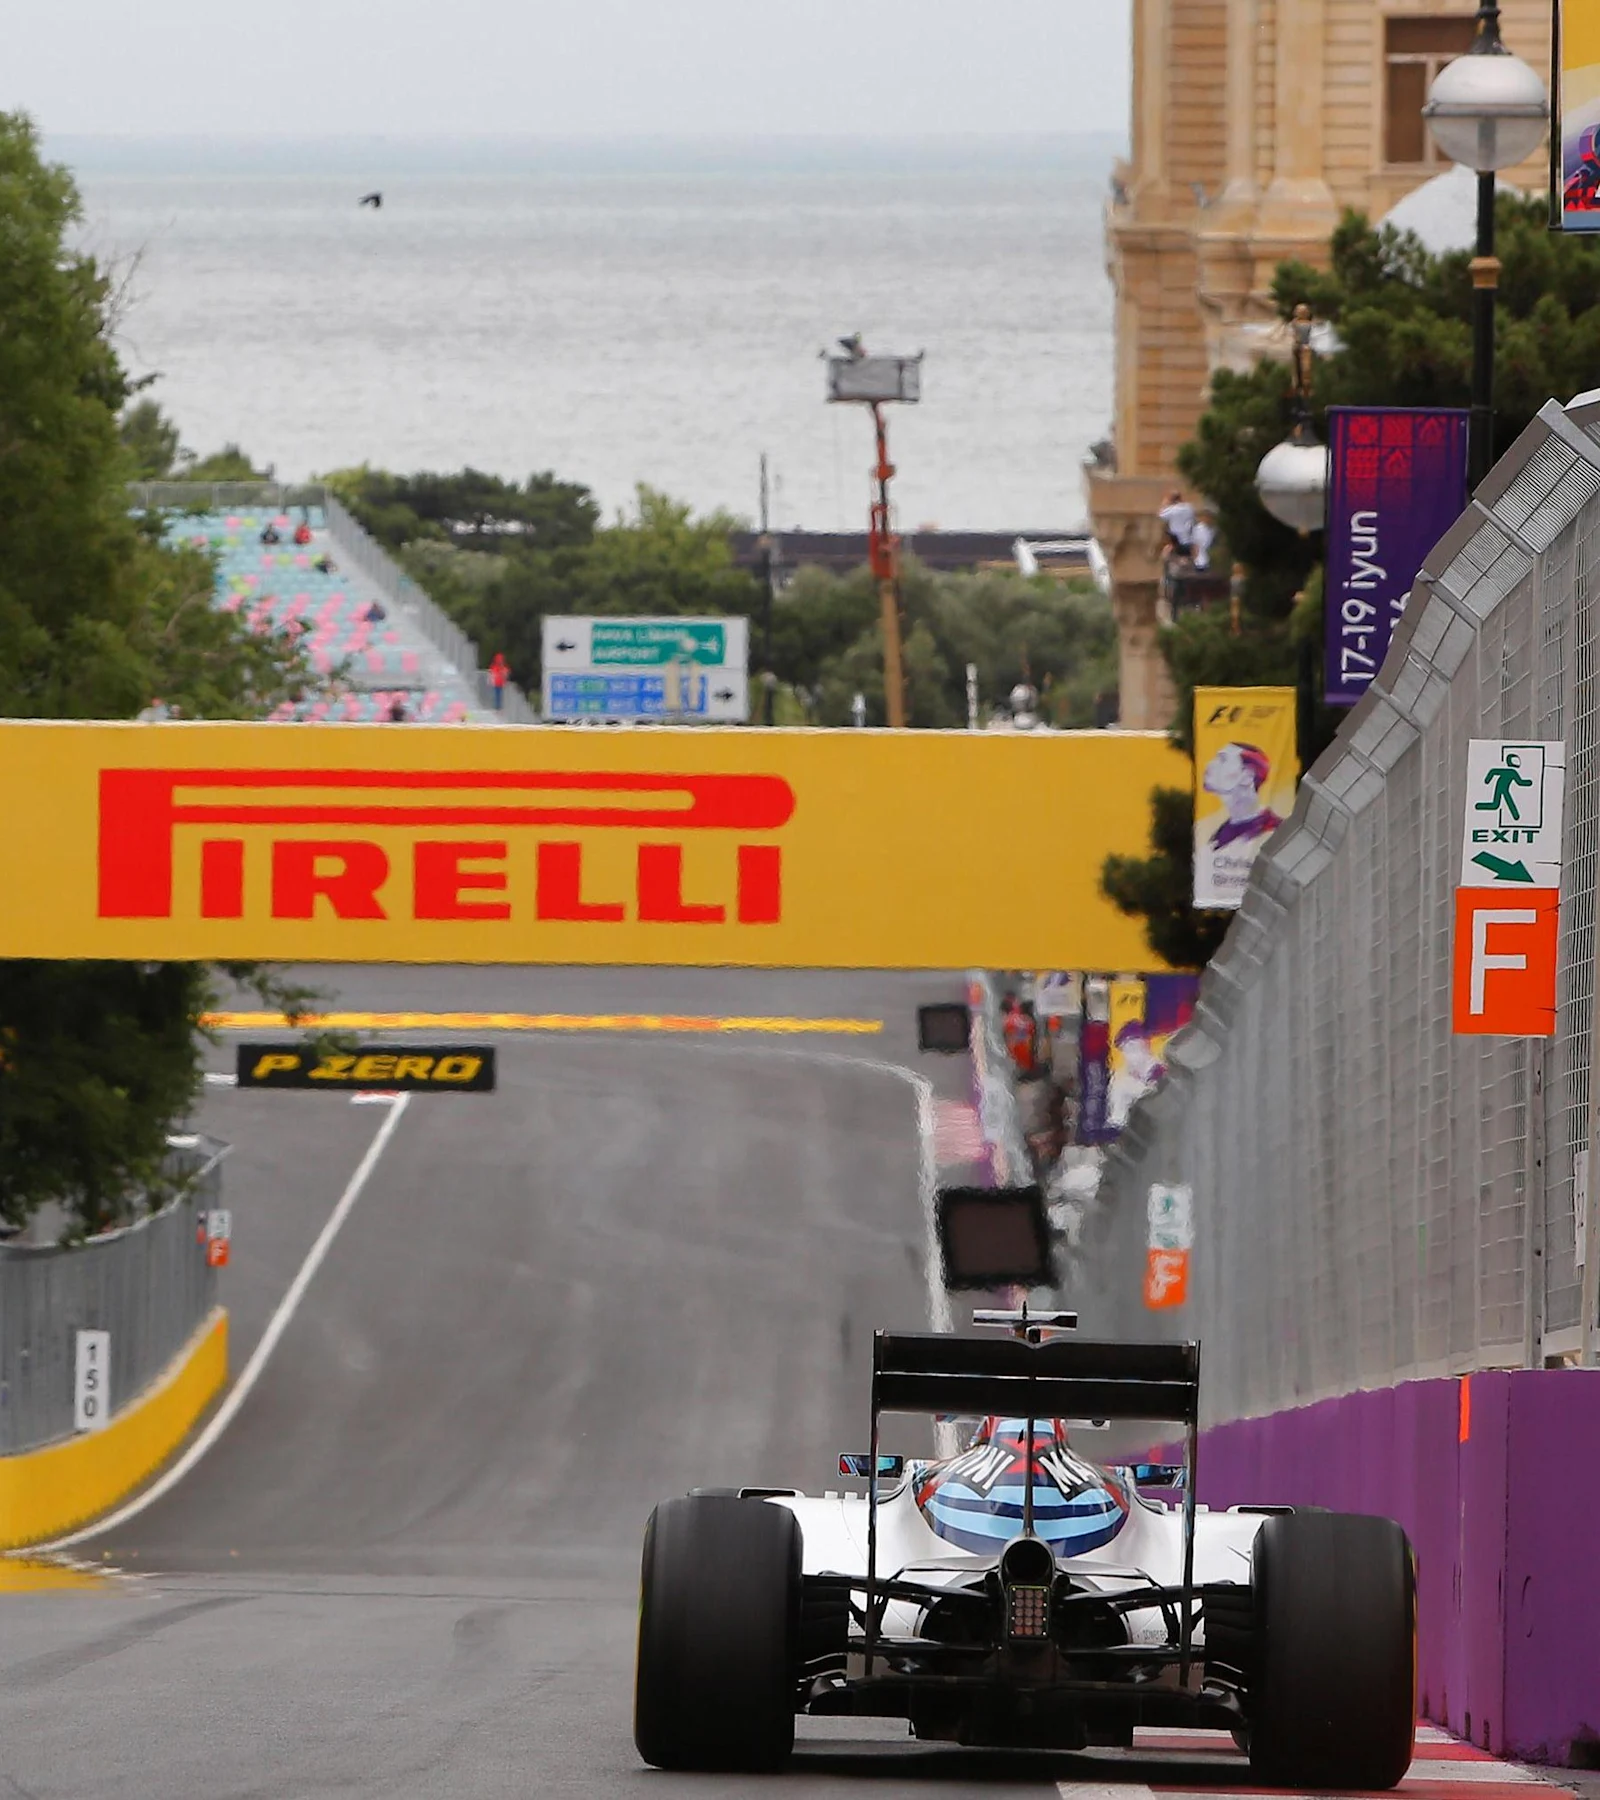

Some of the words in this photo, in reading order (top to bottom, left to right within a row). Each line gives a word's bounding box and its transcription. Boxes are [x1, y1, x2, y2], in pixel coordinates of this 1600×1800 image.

[1343, 511, 1387, 589] iyun
[1341, 598, 1376, 685] 17-19
[97, 768, 797, 925] PIRELLI
[1472, 829, 1540, 844] EXIT
[1470, 909, 1537, 1015] F
[253, 1053, 300, 1080] P
[307, 1054, 484, 1082] ZERO
[1150, 1255, 1184, 1300] F
[84, 1344, 98, 1418] 150
